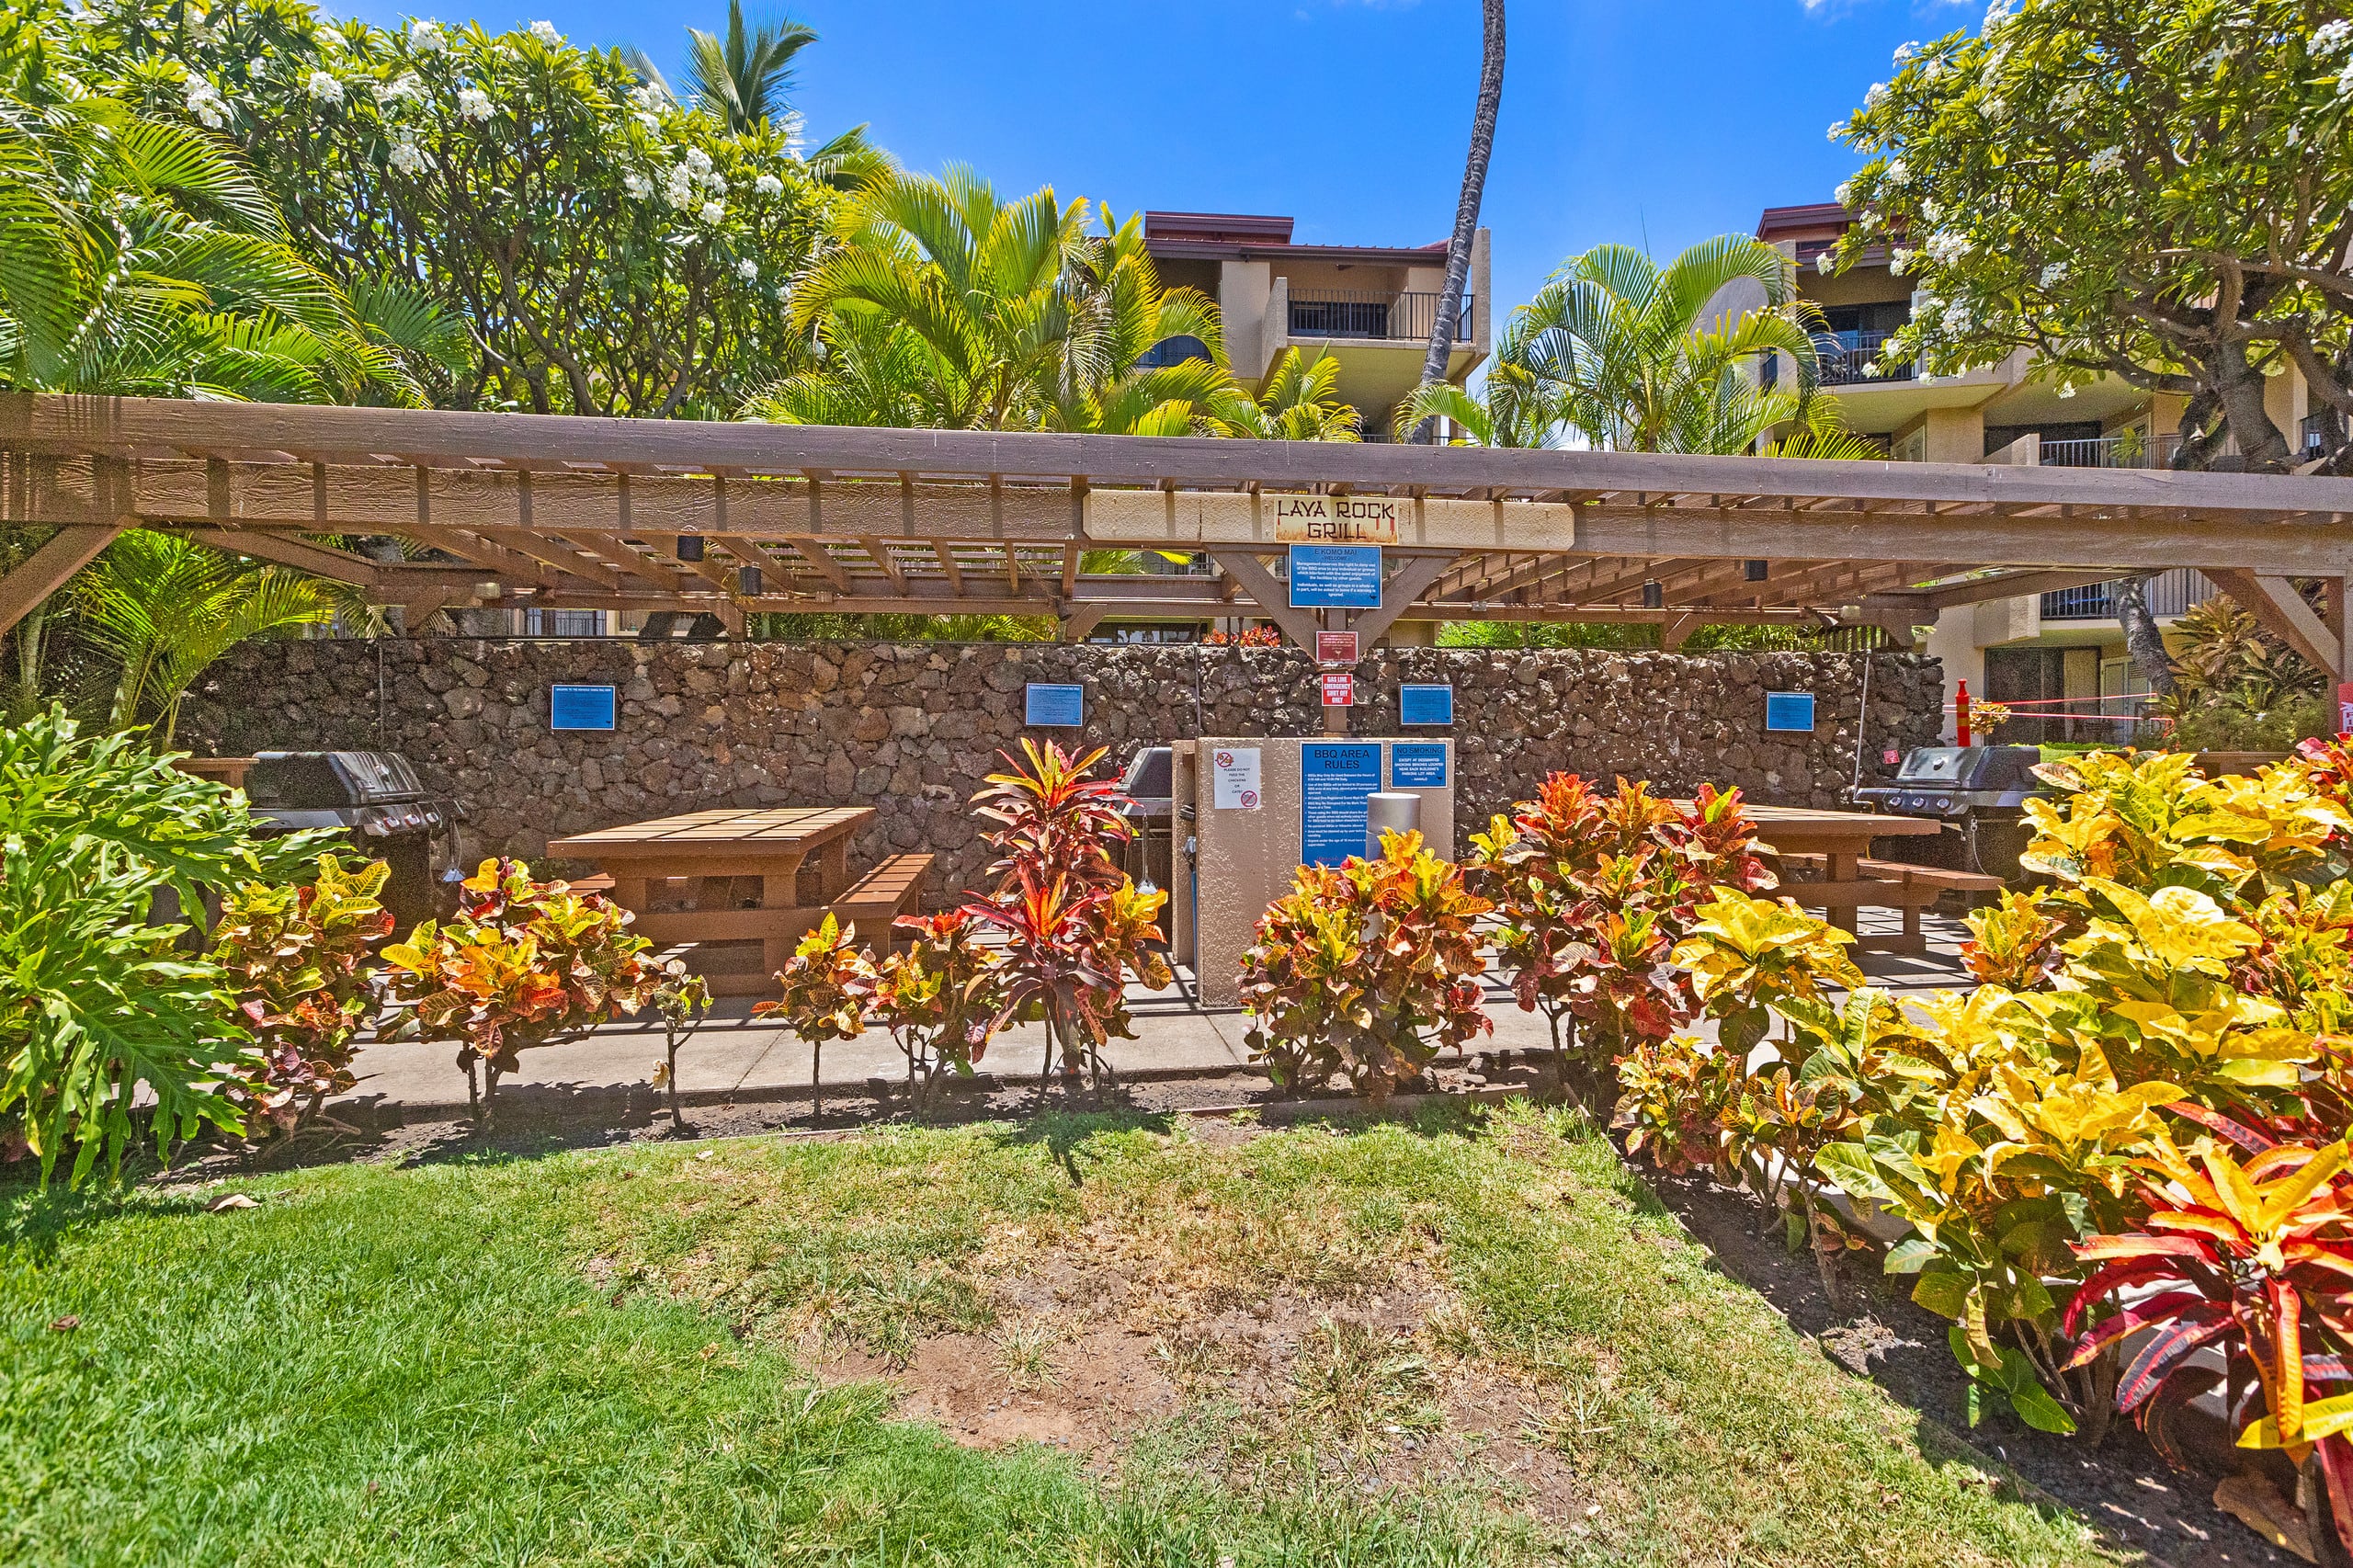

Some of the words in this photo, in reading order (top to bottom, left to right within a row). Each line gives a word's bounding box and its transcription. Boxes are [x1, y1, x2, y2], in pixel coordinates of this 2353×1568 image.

[1336, 501, 1395, 519] ROCK
[1308, 522, 1367, 539] GRILL
[1314, 750, 1338, 758] BBQ
[1340, 750, 1370, 758] AREA
[1324, 760, 1359, 769] RULES
